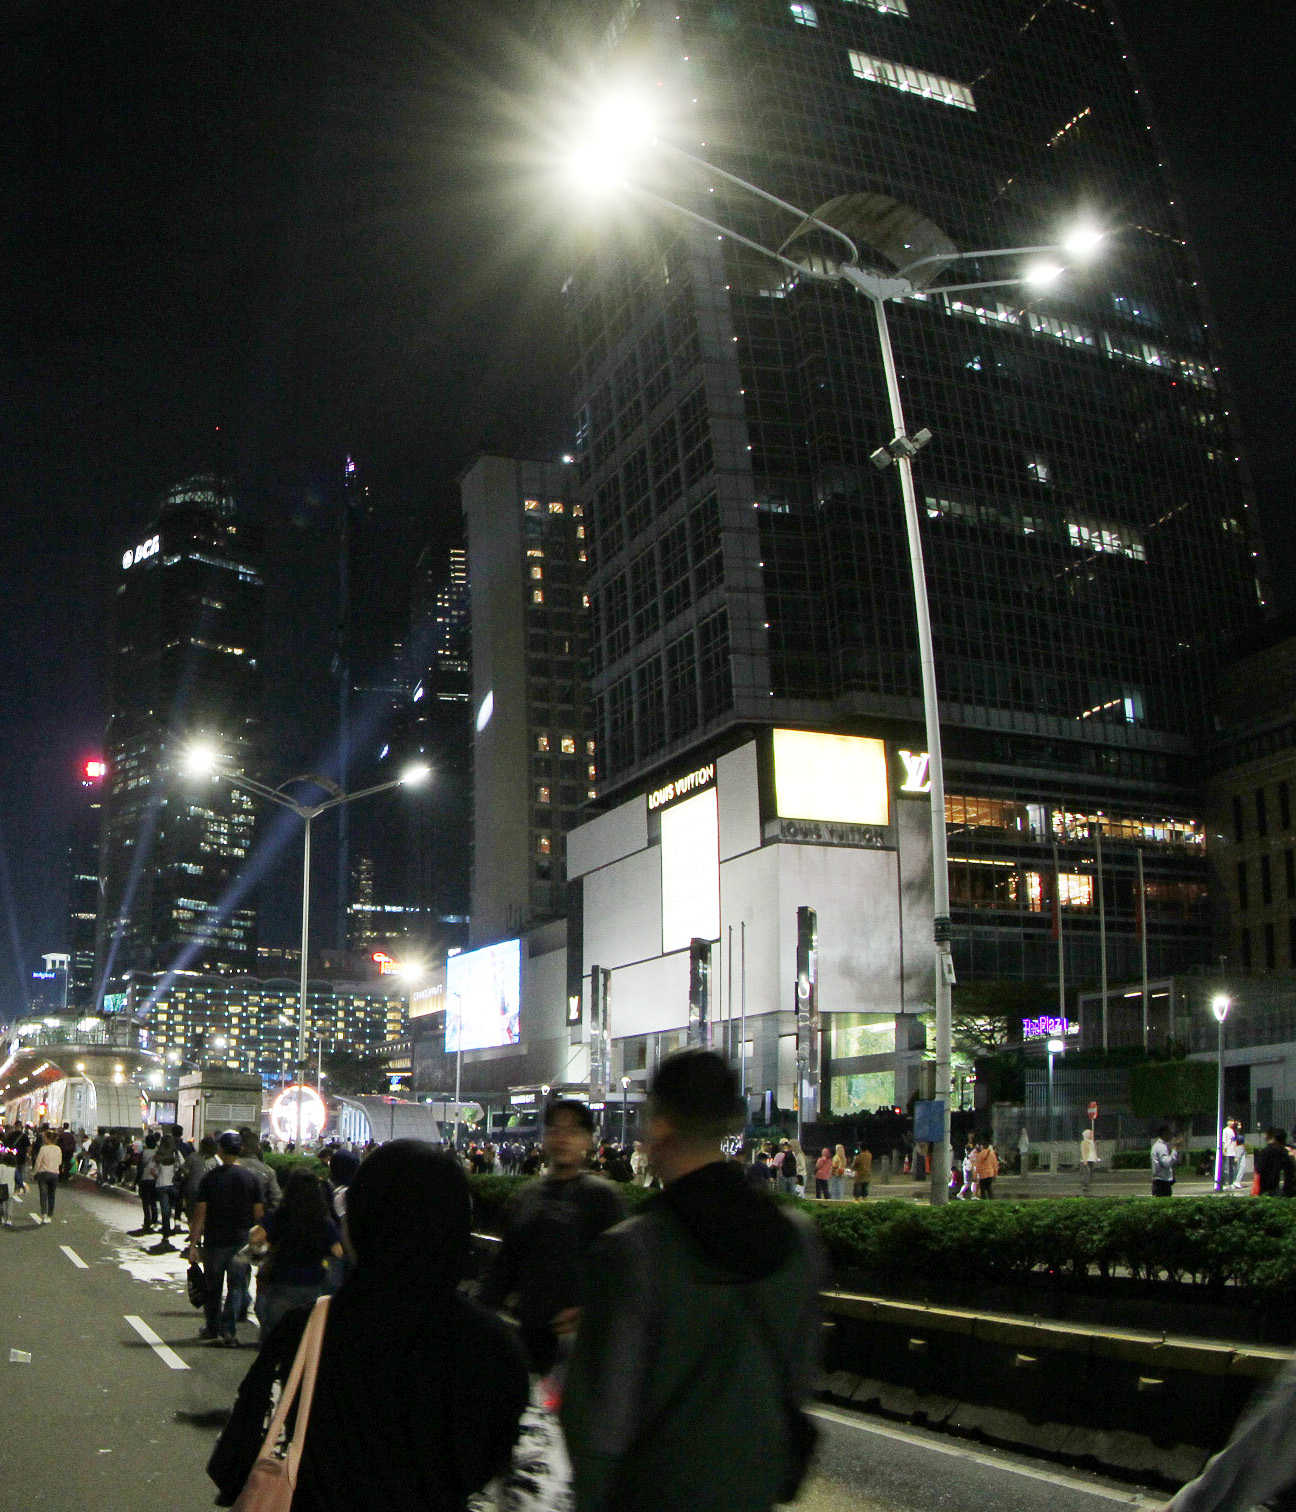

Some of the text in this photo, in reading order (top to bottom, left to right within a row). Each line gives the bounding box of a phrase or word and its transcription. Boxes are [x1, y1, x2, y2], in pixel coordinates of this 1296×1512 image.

[134, 534, 160, 563] BCA
[649, 764, 715, 809] LOUIS VUITTON
